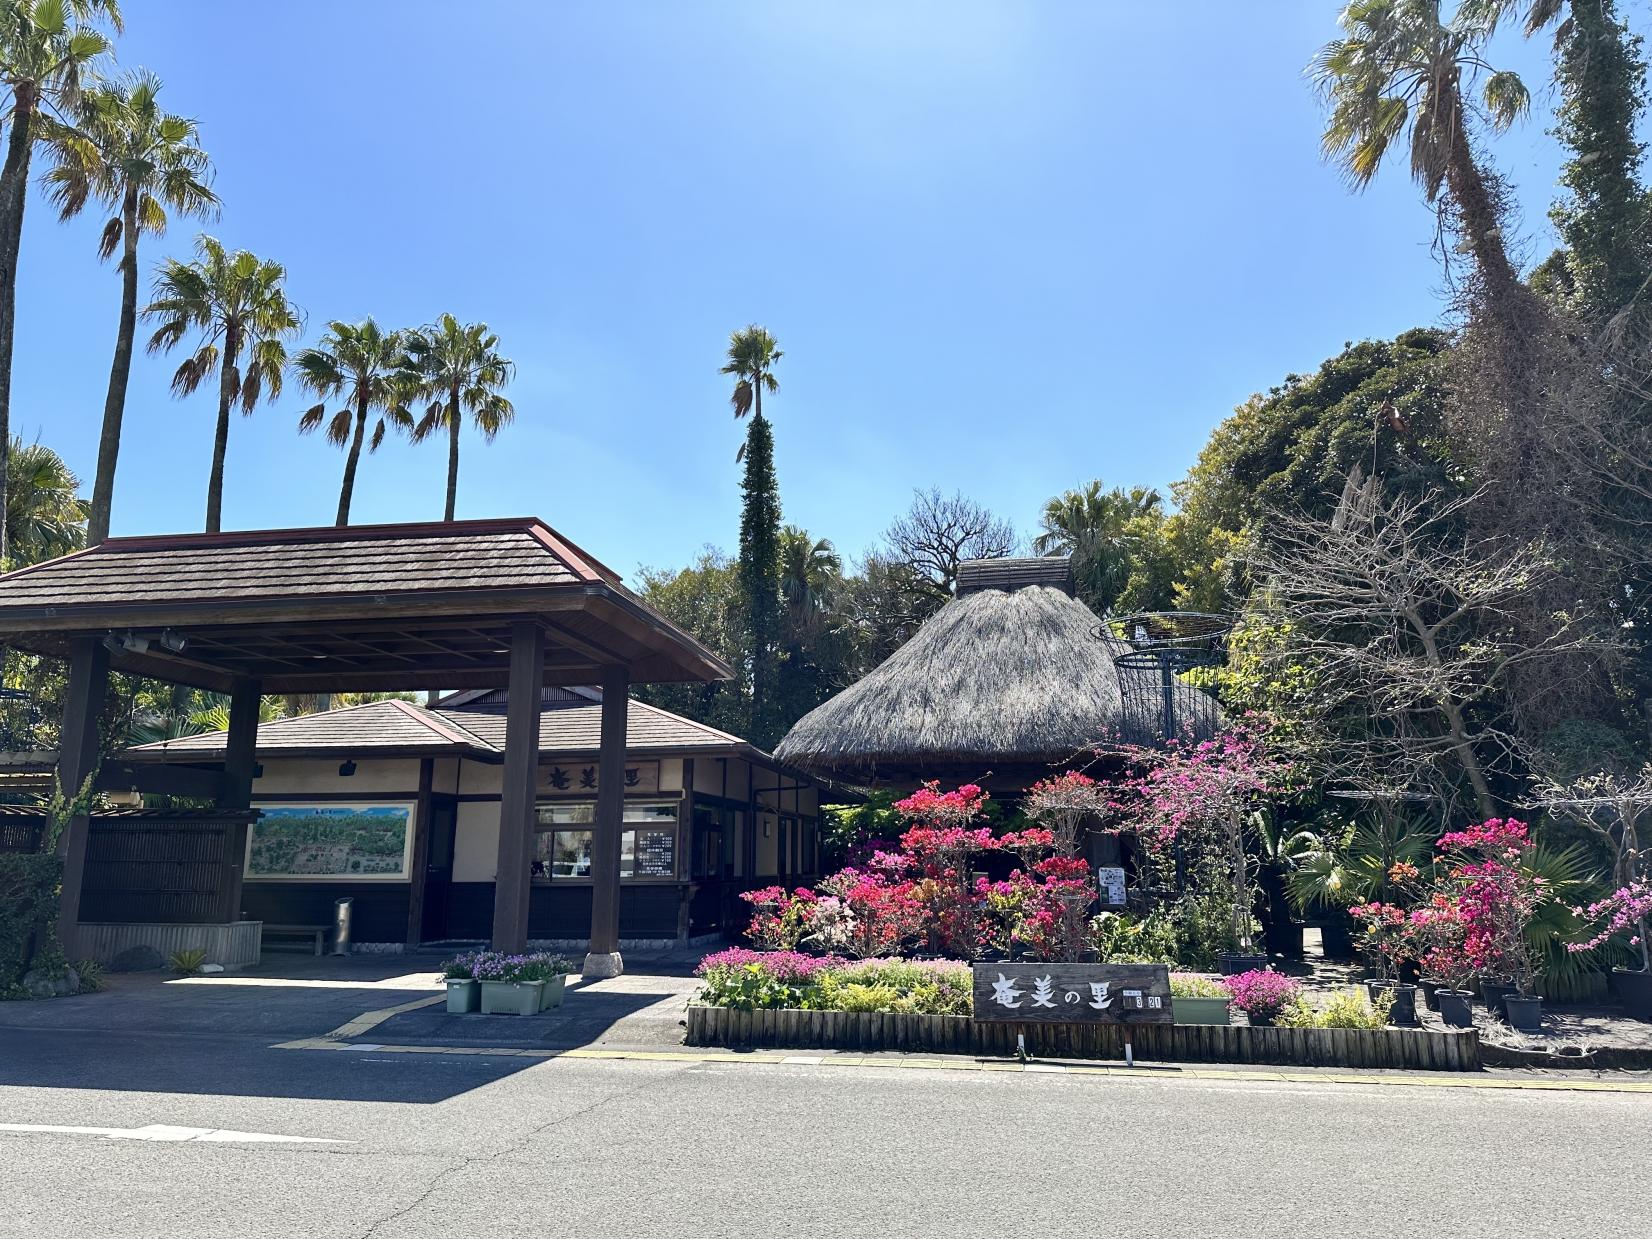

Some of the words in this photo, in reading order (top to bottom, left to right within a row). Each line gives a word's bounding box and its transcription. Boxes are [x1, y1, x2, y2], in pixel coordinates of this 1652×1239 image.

[547, 766, 641, 790] 奄美里
[989, 972, 1114, 1009] 奄美の里
